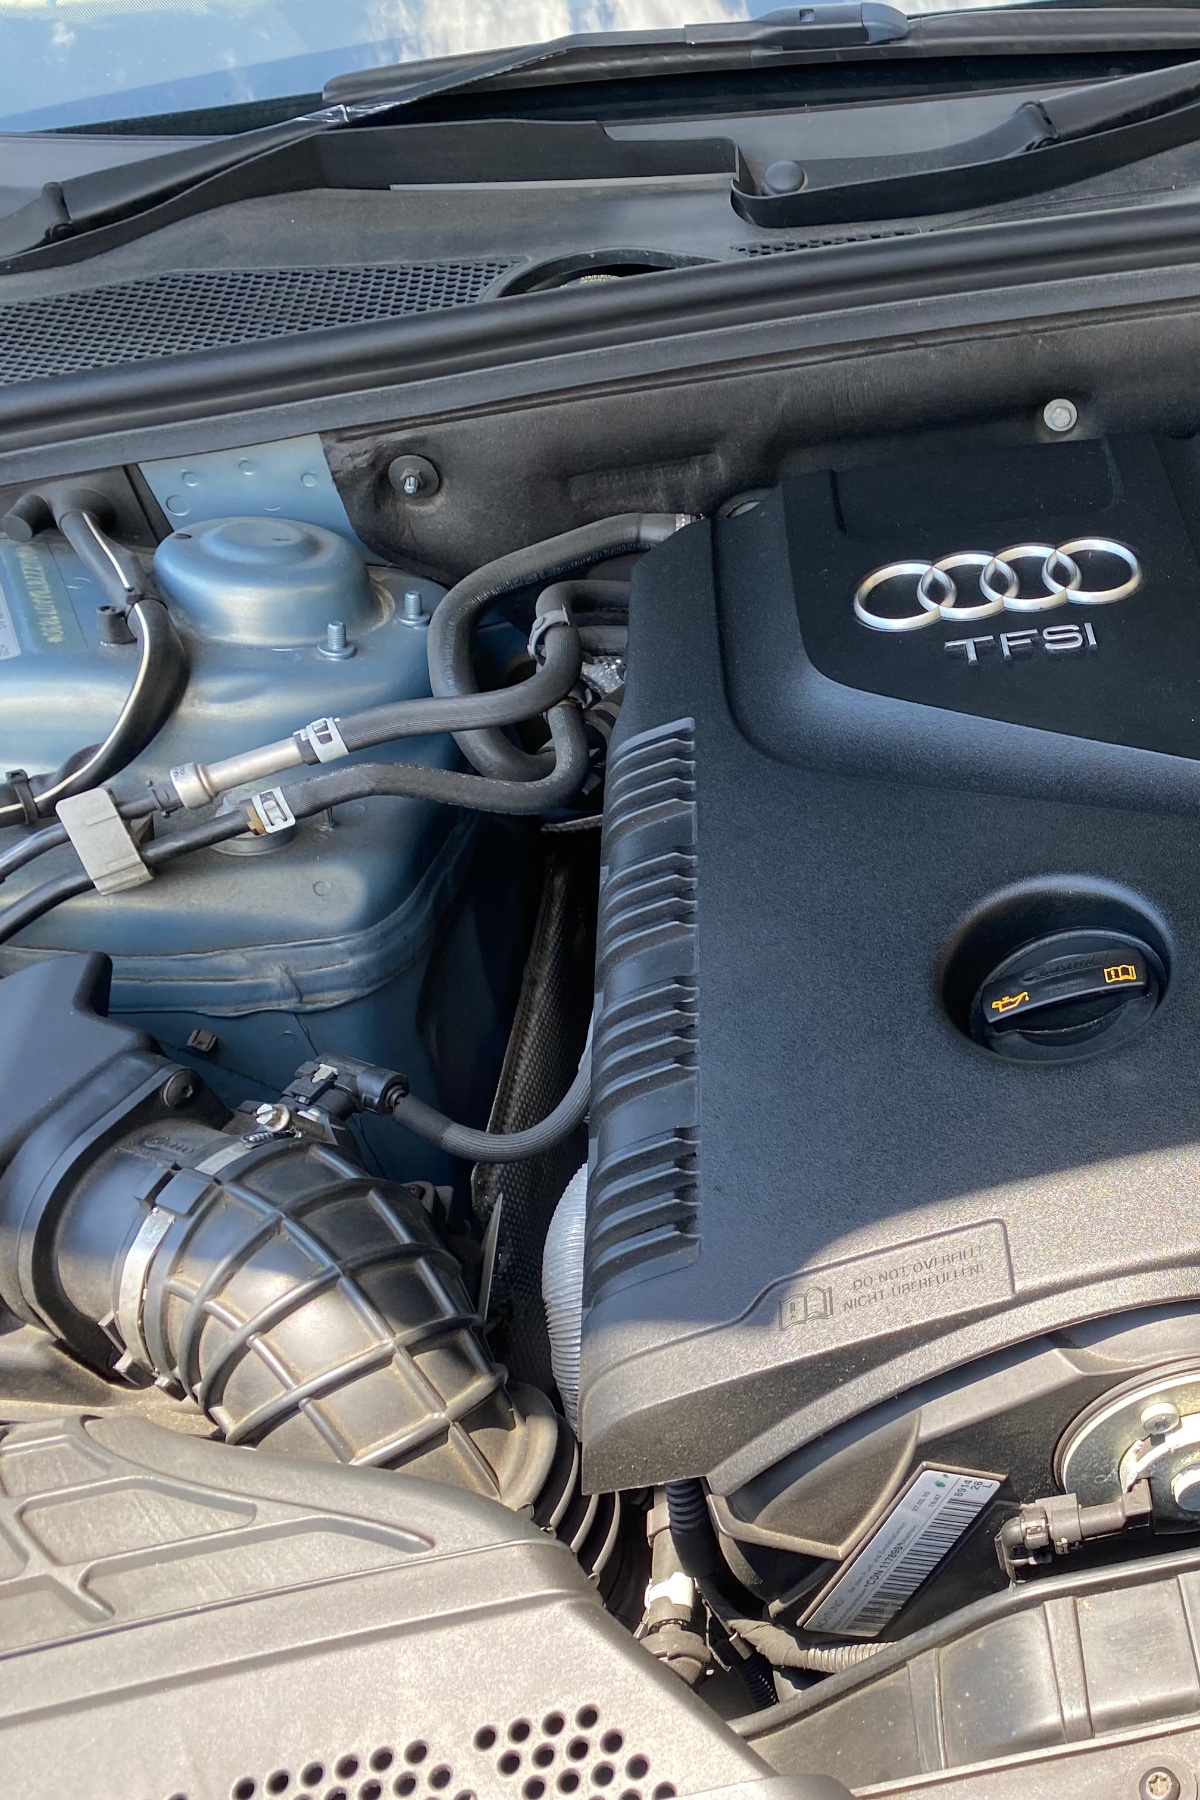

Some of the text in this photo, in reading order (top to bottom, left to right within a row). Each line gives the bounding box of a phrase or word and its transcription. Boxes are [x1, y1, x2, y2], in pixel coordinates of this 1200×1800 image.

[943, 622, 1098, 666] TFSI
[852, 1275, 873, 1291] DO
[878, 1266, 906, 1284] NOT
[843, 1290, 886, 1312] NICHT
